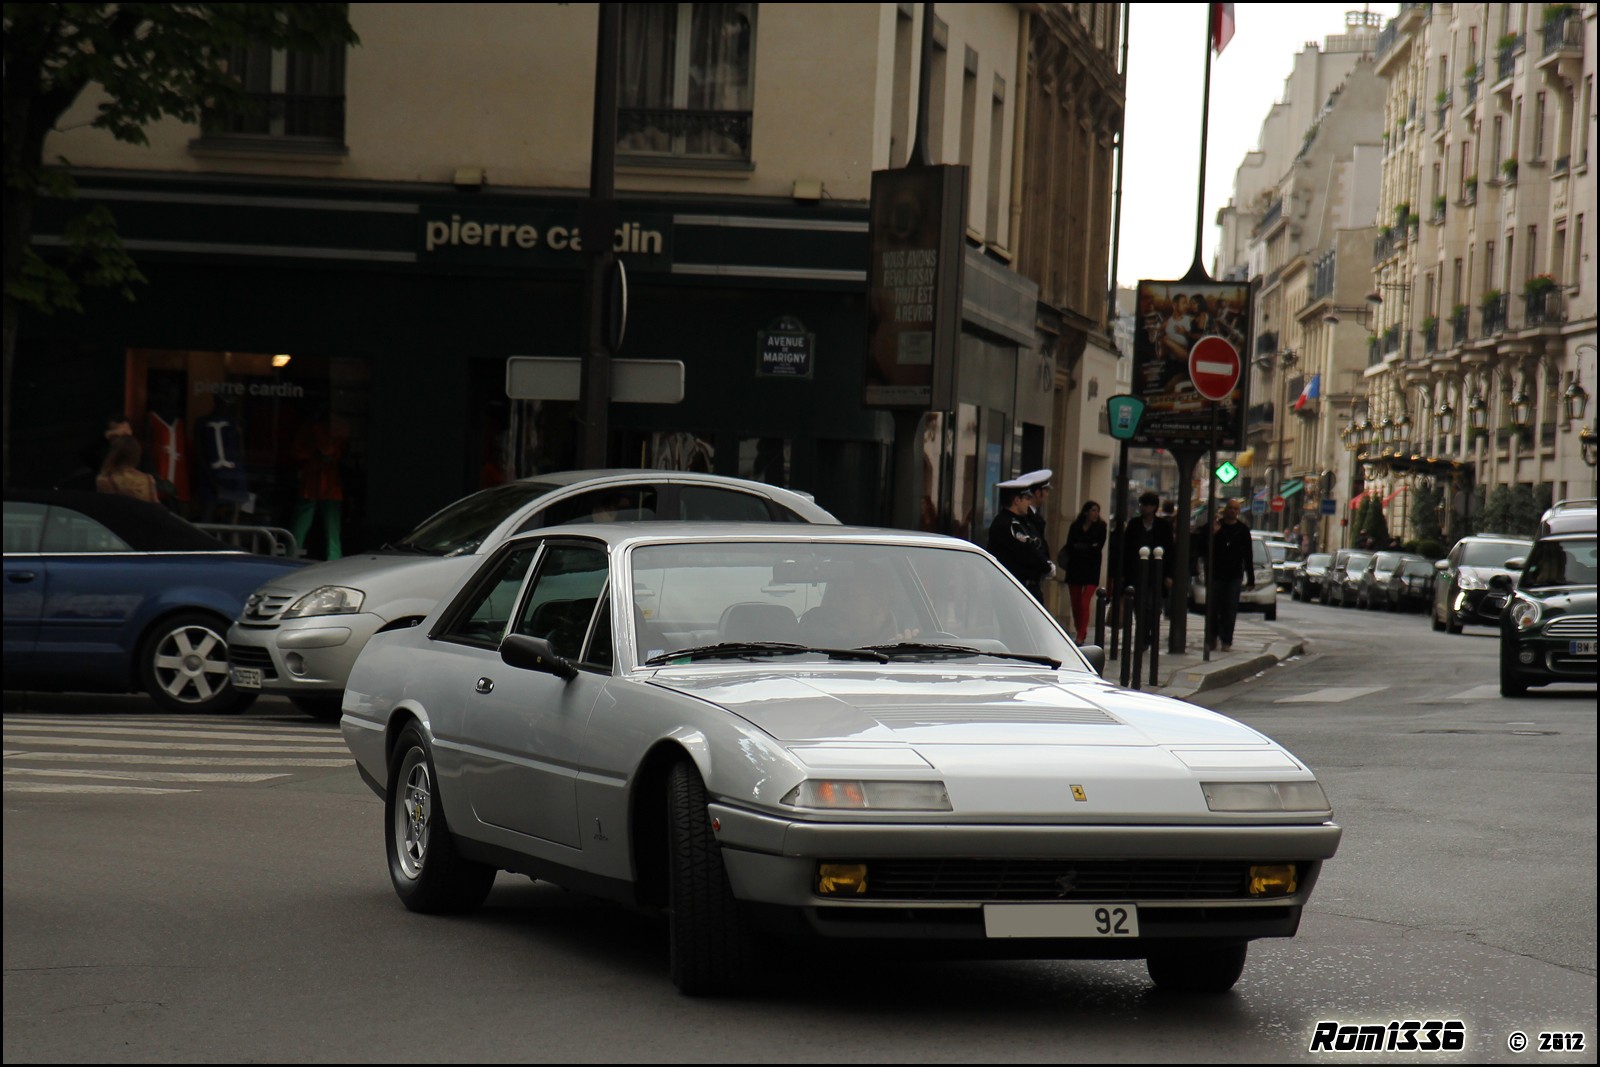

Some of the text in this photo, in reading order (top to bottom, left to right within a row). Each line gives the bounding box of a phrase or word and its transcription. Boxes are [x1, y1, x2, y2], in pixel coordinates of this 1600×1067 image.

[425, 214, 662, 255] pierre cadin
[906, 249, 937, 268] AVONS
[917, 286, 934, 304] EST
[767, 335, 805, 348] AVENUE
[763, 352, 807, 364] MARIGNY
[193, 379, 304, 399] pierre cardin
[1095, 908, 1129, 934] 92
